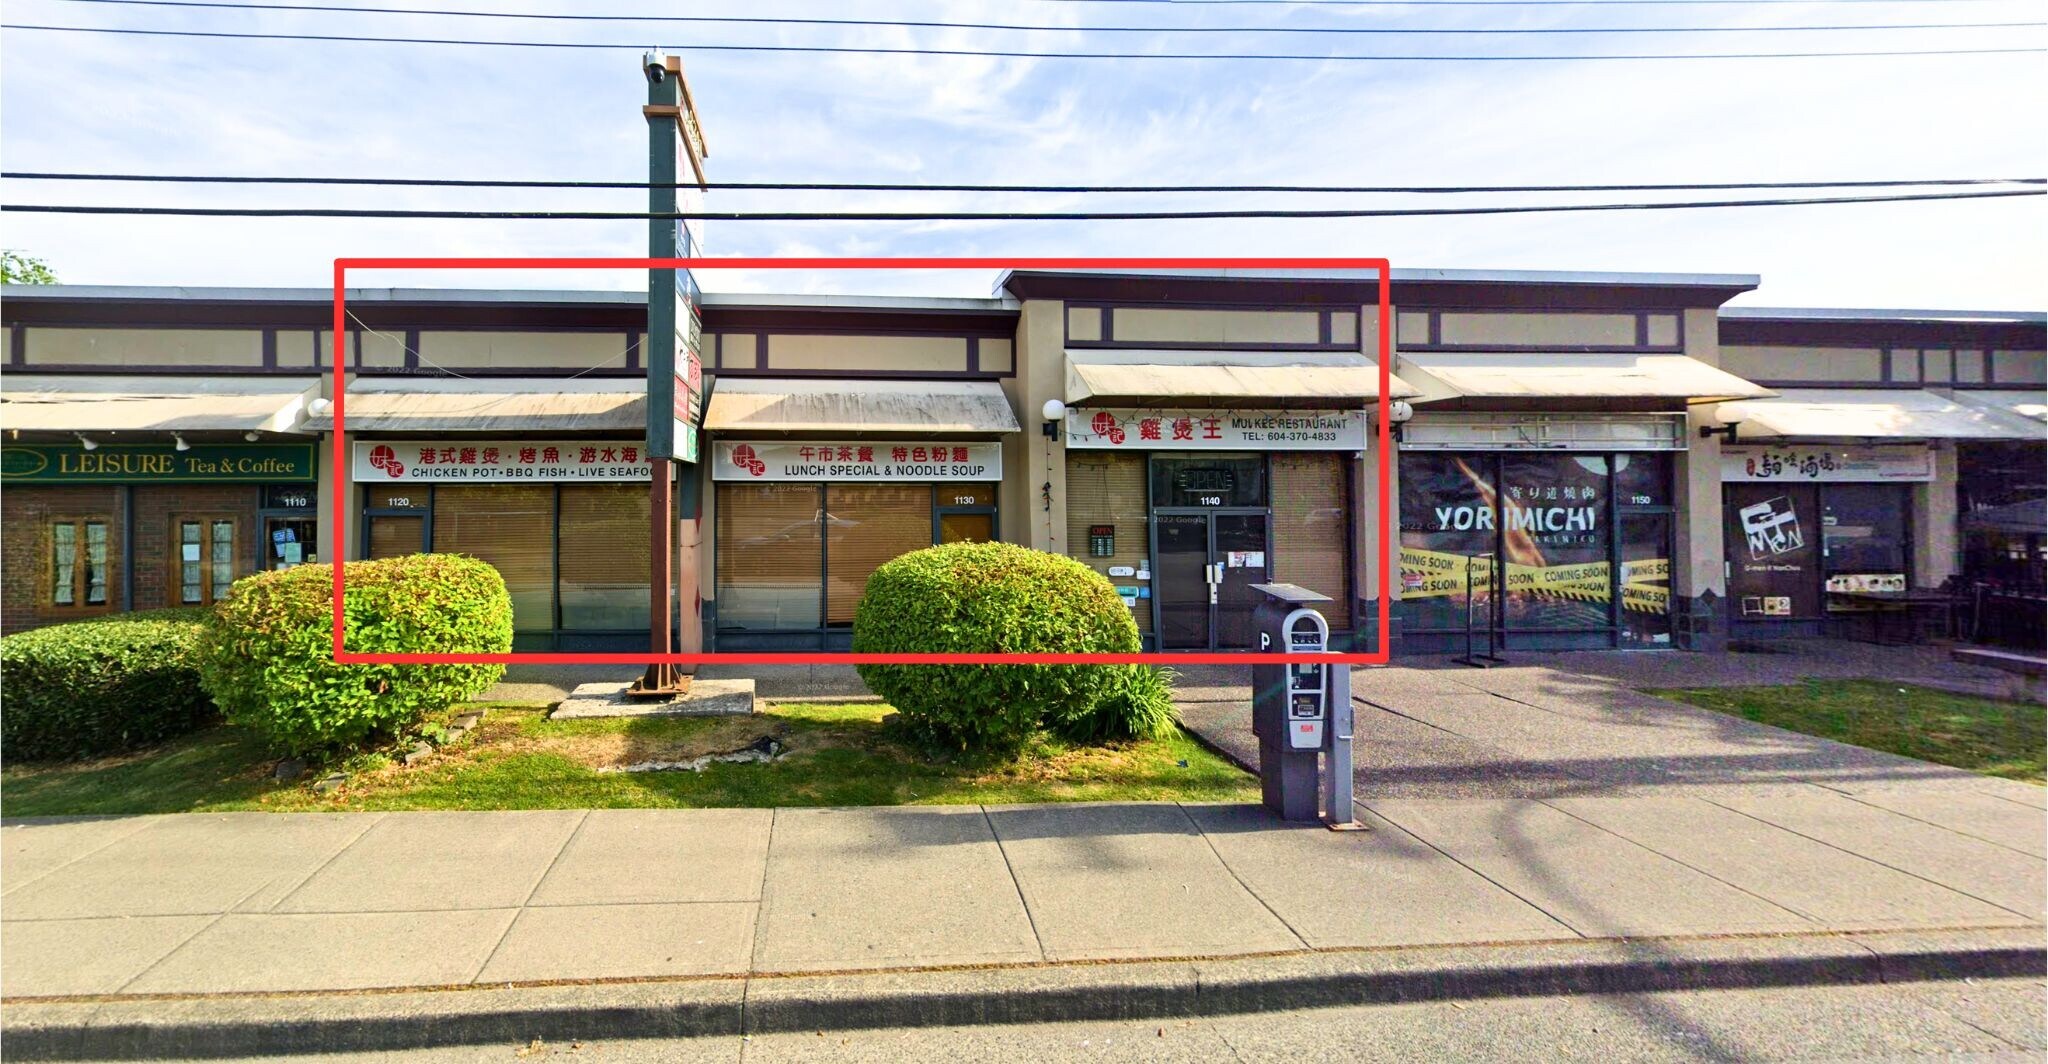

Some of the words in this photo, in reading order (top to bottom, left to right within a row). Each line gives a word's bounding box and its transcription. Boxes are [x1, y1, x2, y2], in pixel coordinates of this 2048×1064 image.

[1277, 418, 1348, 429] RESTAURANT
[1242, 431, 1265, 441] TEL:
[1268, 431, 1337, 441] 604-370-4833
[799, 446, 874, 463] 午市茶餐
[60, 454, 176, 474] LEISURE
[184, 458, 217, 473] Tea
[220, 458, 235, 473] &
[238, 458, 295, 473] Coffee
[412, 467, 468, 477] CHICKEN
[472, 467, 497, 477] POT
[506, 467, 534, 478] BBQ
[538, 467, 567, 477] FISH
[578, 467, 605, 477] LIVE
[785, 465, 826, 476] LUNCH
[829, 465, 880, 476] SPECIAL
[884, 465, 893, 476] &
[896, 465, 948, 476] NOODLE
[951, 465, 985, 476] SOUP
[285, 498, 307, 507] 1110
[388, 497, 410, 506] 1120
[954, 496, 975, 505] 1130
[1200, 496, 1221, 506] 1140
[1631, 495, 1651, 505] 1150
[1508, 573, 1535, 585] SOON
[1544, 569, 1581, 583] COMING
[1582, 566, 1609, 579] SOON
[1261, 632, 1270, 651] P
